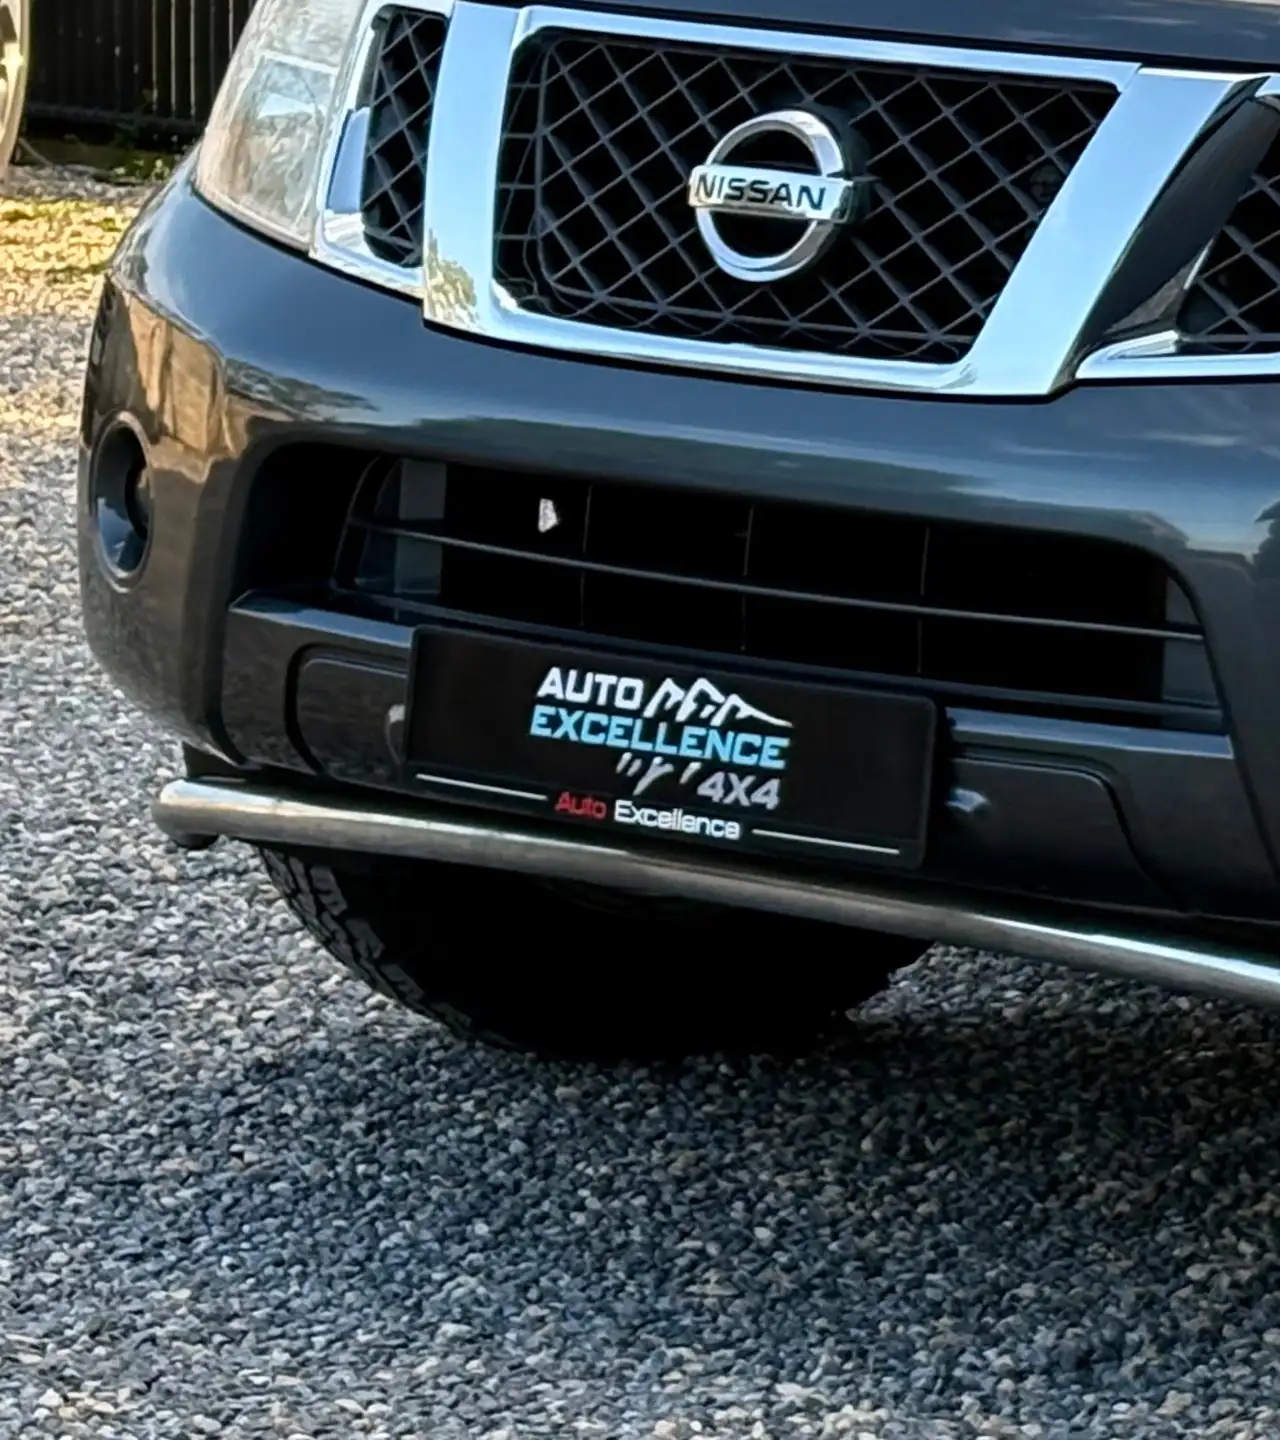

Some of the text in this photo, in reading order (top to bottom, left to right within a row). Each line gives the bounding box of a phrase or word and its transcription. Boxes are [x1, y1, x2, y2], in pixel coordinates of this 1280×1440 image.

[694, 171, 827, 211] NISSAN
[536, 666, 644, 710] AUTO
[529, 703, 791, 771] EXCELLENCE
[697, 770, 782, 811] 4X4
[555, 791, 741, 841] Auto Excellence
